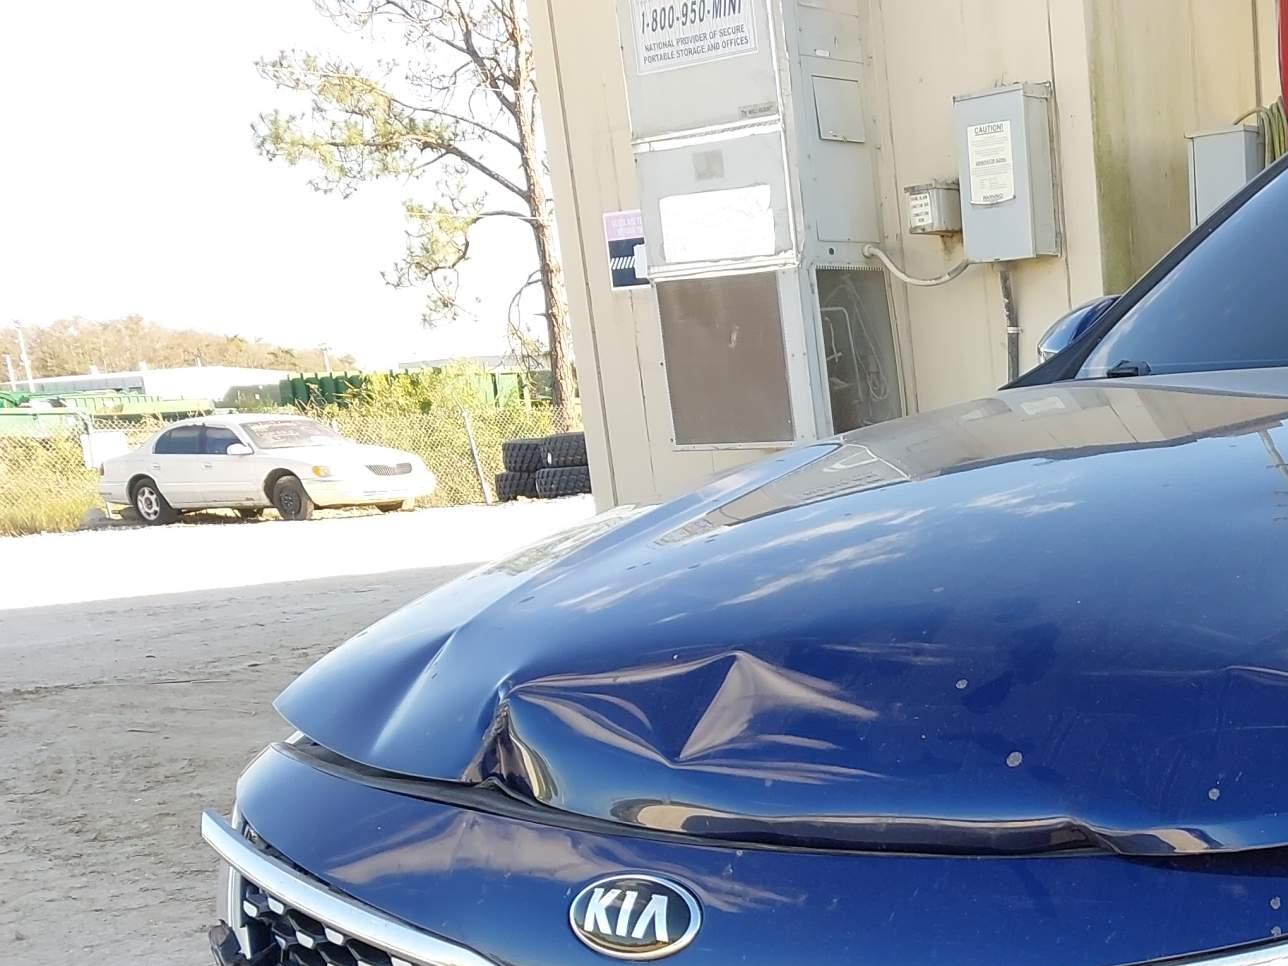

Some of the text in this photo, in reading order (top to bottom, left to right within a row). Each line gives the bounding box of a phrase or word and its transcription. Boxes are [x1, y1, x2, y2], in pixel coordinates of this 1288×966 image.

[643, 36, 749, 65] PORTABLE STORAGE AND OFFICES
[645, 23, 745, 53] NATIONAL PROVIDER OF SECURE
[583, 887, 669, 942] KIA
